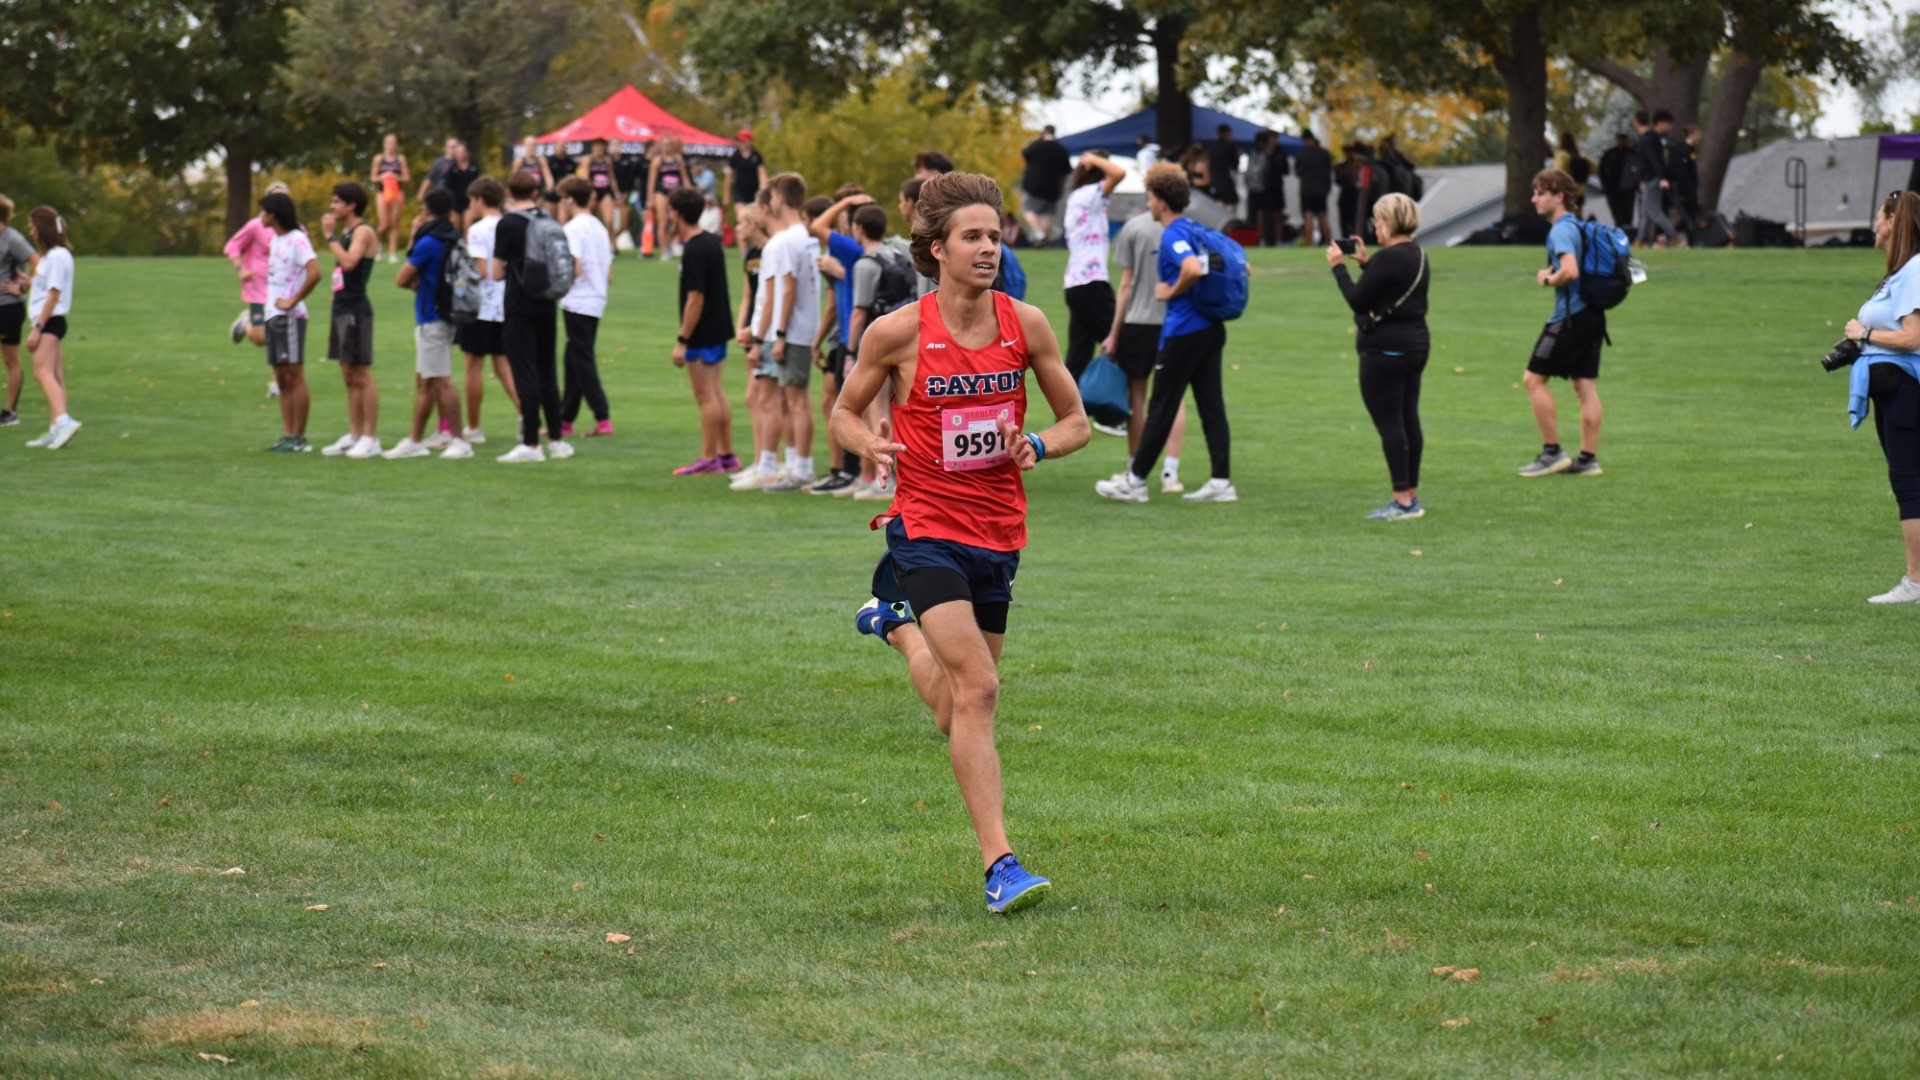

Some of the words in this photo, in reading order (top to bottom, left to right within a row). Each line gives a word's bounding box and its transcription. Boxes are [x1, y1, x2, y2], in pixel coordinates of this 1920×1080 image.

[926, 368, 1024, 397] DAYTON
[965, 410, 998, 419] BRADLEY
[954, 431, 1006, 458] 9591
